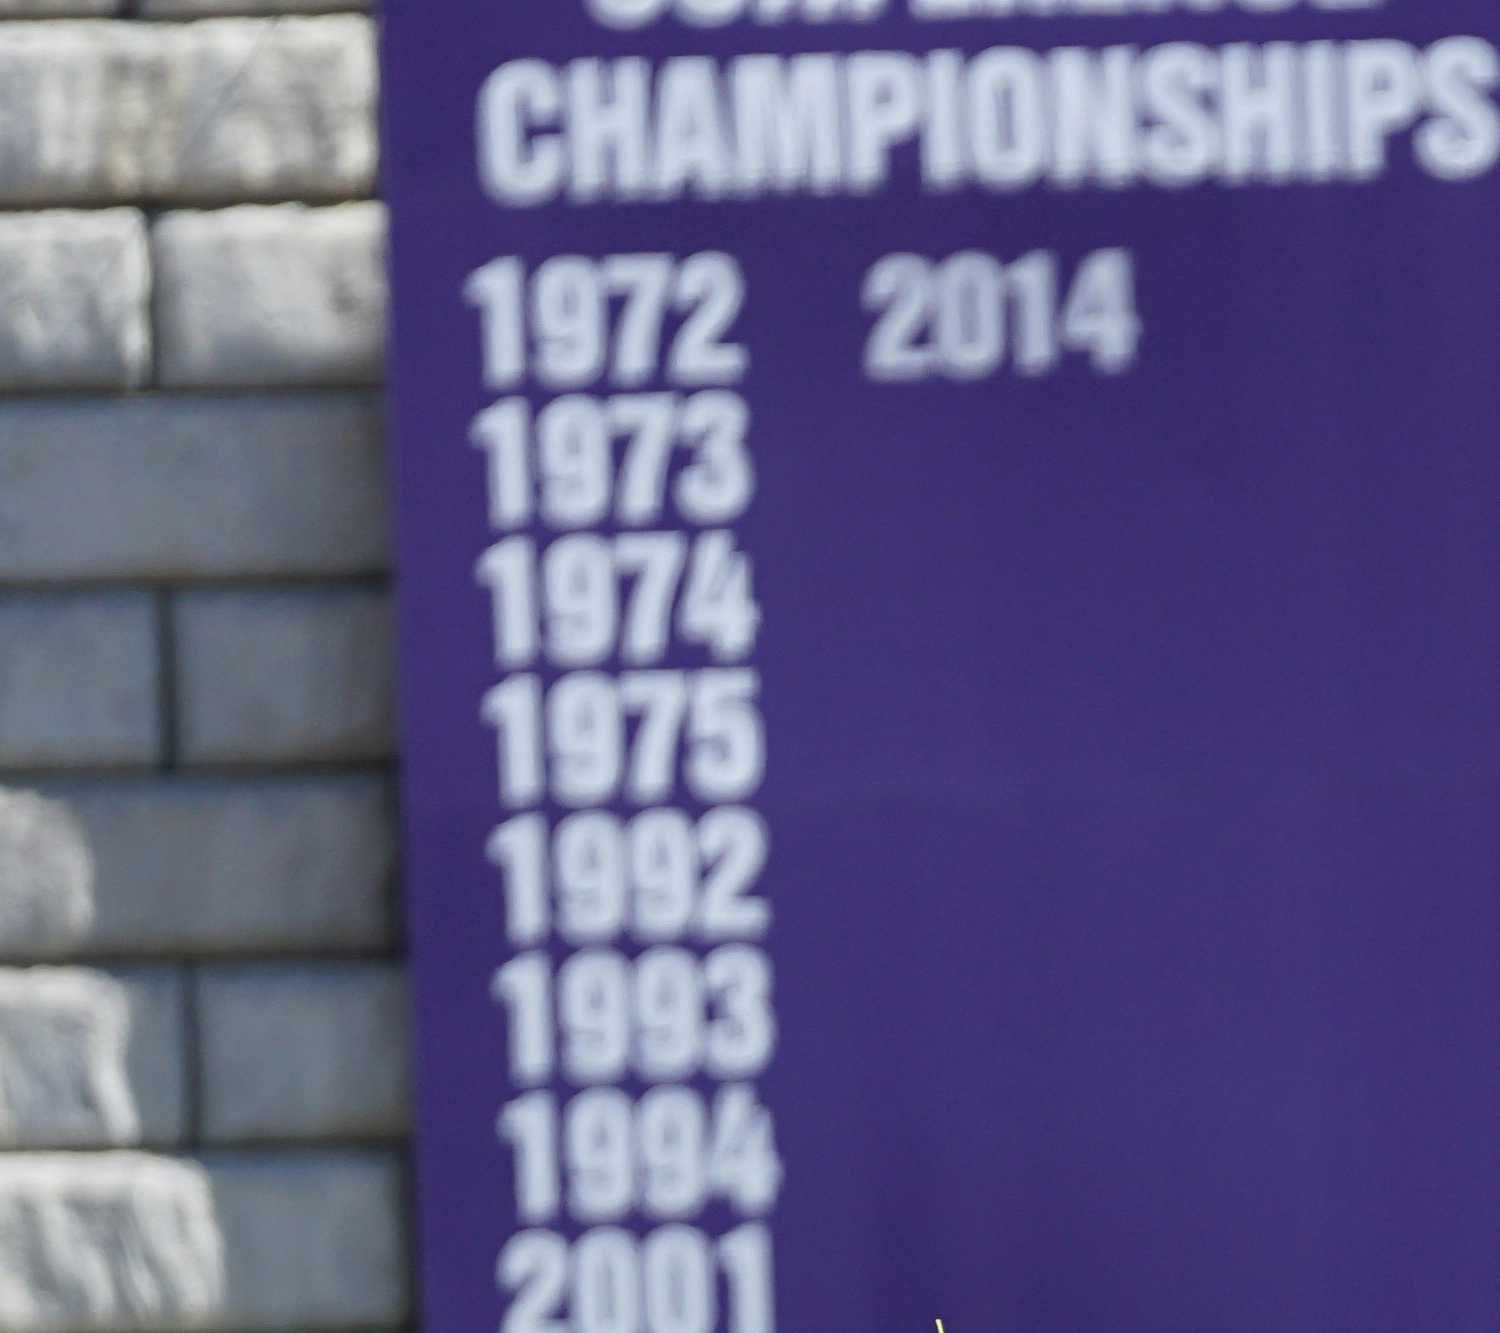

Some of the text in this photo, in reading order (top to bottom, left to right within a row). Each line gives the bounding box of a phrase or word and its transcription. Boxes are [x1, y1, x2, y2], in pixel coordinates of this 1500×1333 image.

[468, 252, 746, 387] 1972
[866, 248, 1138, 379] 2014
[474, 389, 752, 528] 1973
[479, 530, 760, 667] 1974
[484, 667, 765, 806] 1975
[490, 806, 769, 943] 1992
[496, 943, 775, 1083] 1993
[501, 1084, 781, 1222] 1994
